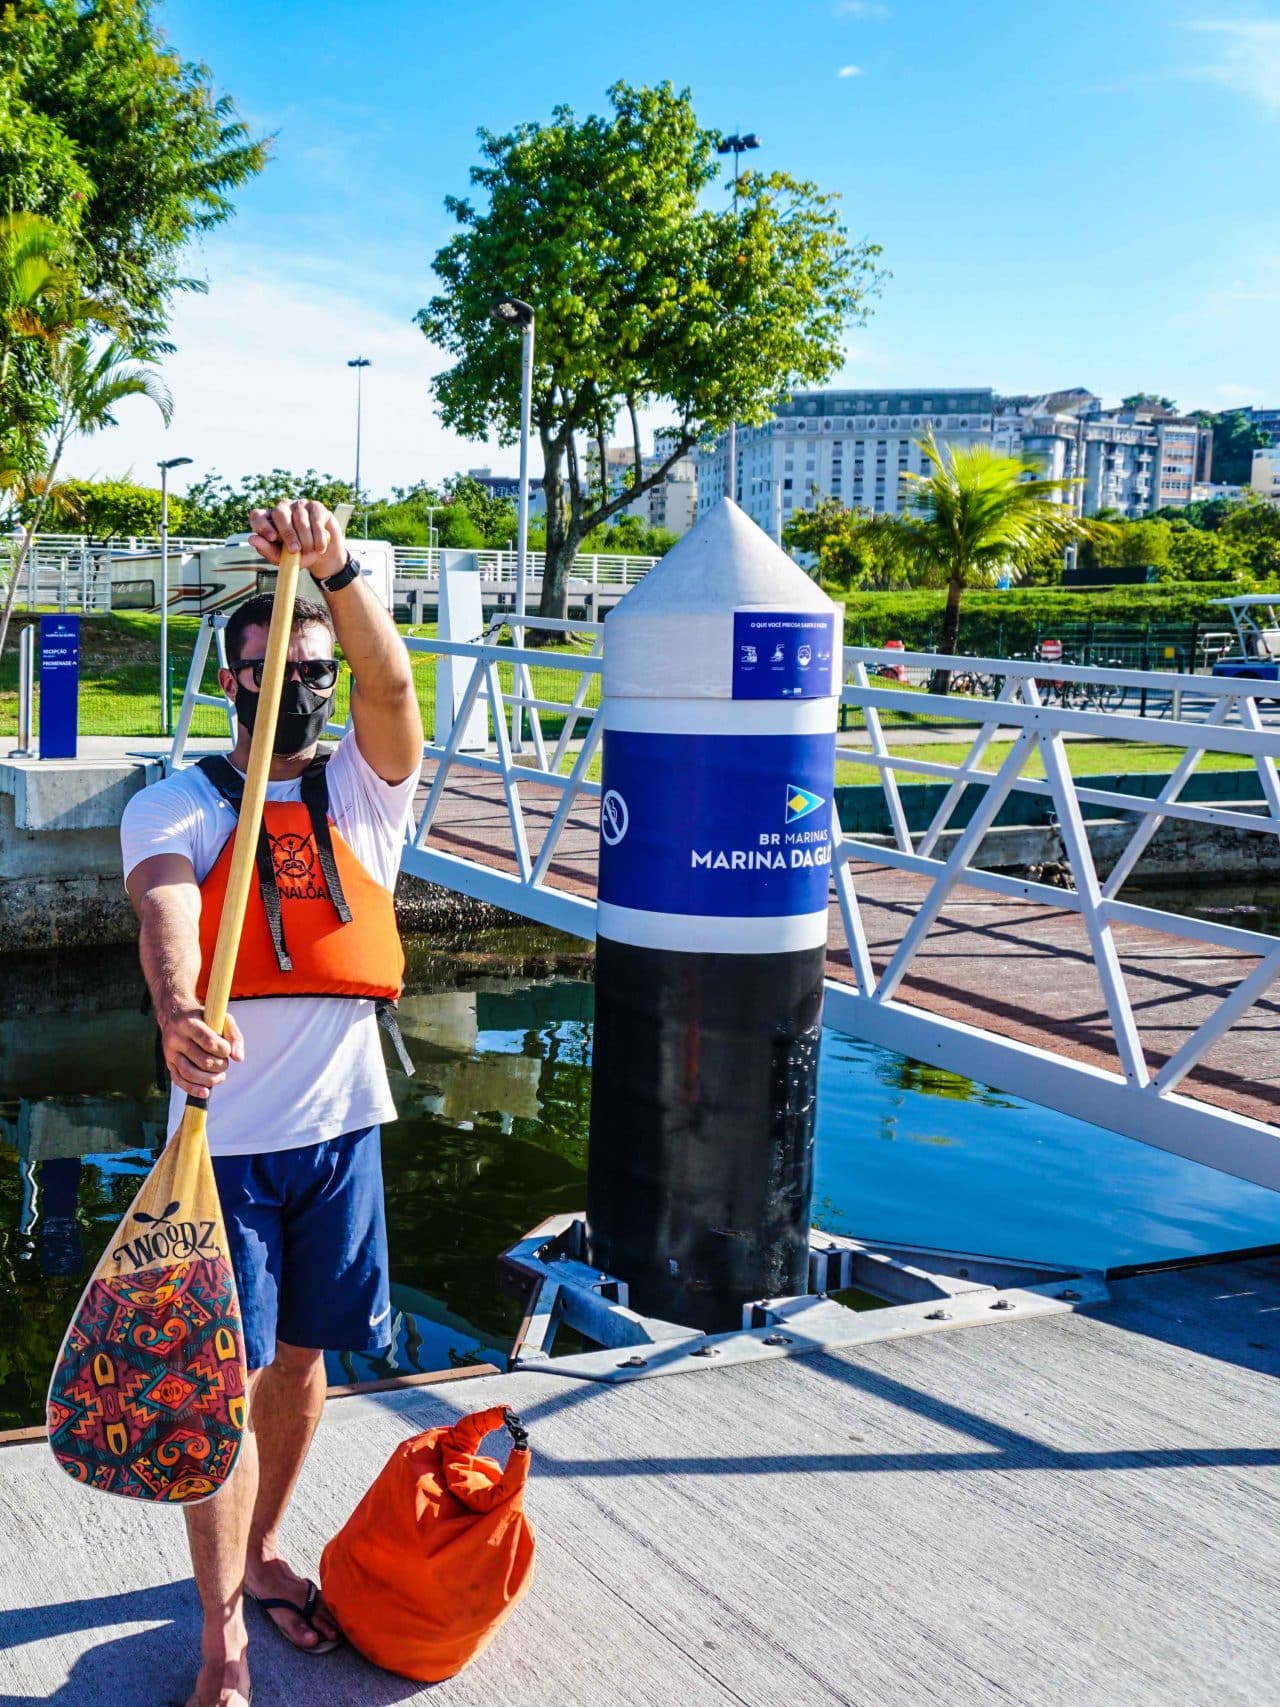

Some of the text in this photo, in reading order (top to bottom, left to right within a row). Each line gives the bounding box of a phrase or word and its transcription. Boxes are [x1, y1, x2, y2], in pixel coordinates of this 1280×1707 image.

[759, 830, 828, 845] BR MARINAS
[691, 849, 787, 870] MARINA
[791, 848, 814, 868] DA
[112, 1221, 221, 1270] WOODZ
